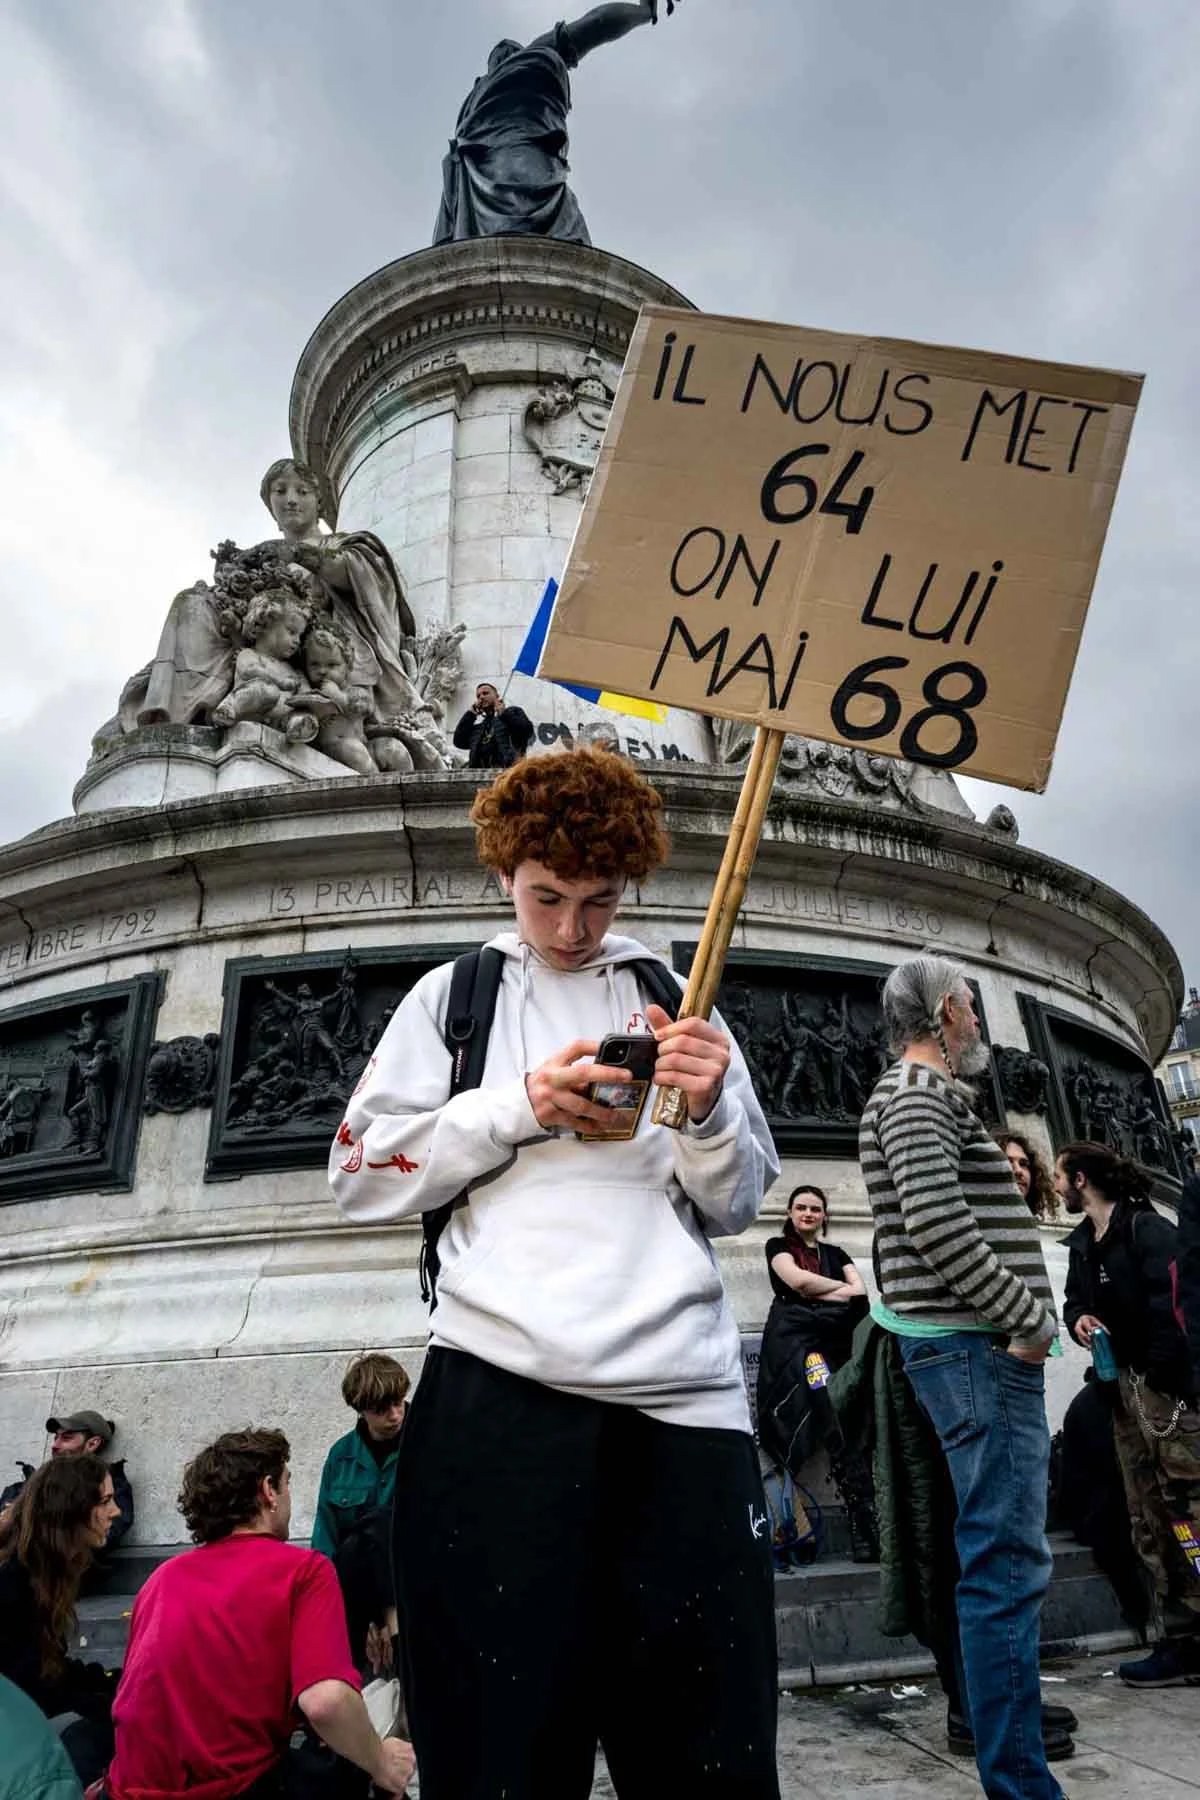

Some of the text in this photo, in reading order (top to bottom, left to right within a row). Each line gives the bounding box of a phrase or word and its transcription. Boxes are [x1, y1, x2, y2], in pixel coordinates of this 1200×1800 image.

[741, 353, 933, 435] NOUS
[961, 388, 1109, 473] MET
[761, 444, 874, 534] 64
[670, 526, 781, 607] ON
[830, 656, 987, 769] 68
[97, 908, 158, 945] 1792
[268, 887, 296, 914] 13
[479, 869, 513, 898] A
[762, 885, 873, 923] JUILLET
